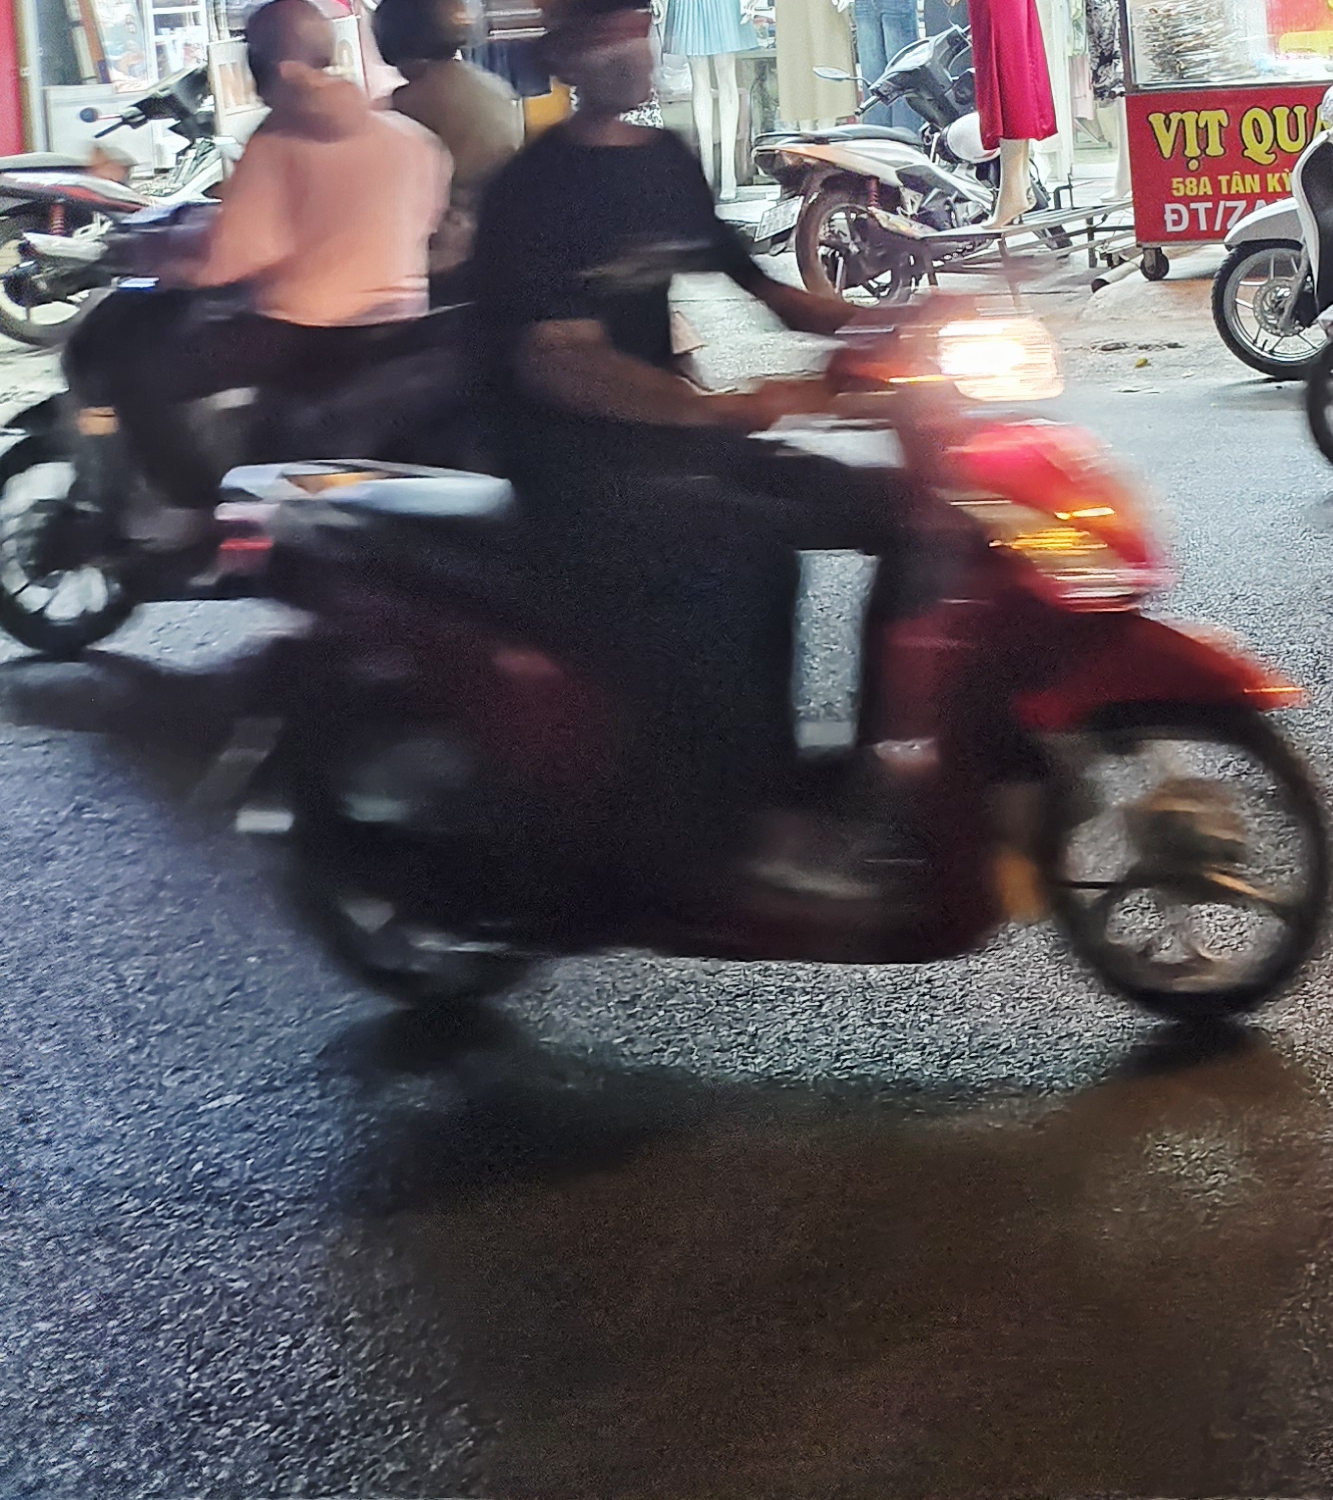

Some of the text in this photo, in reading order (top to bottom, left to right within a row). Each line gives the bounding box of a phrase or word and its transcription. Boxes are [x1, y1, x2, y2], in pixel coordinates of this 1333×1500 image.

[1148, 108, 1229, 172] VỊT
[1171, 175, 1213, 197] 58A
[1218, 170, 1261, 195] TÂN
